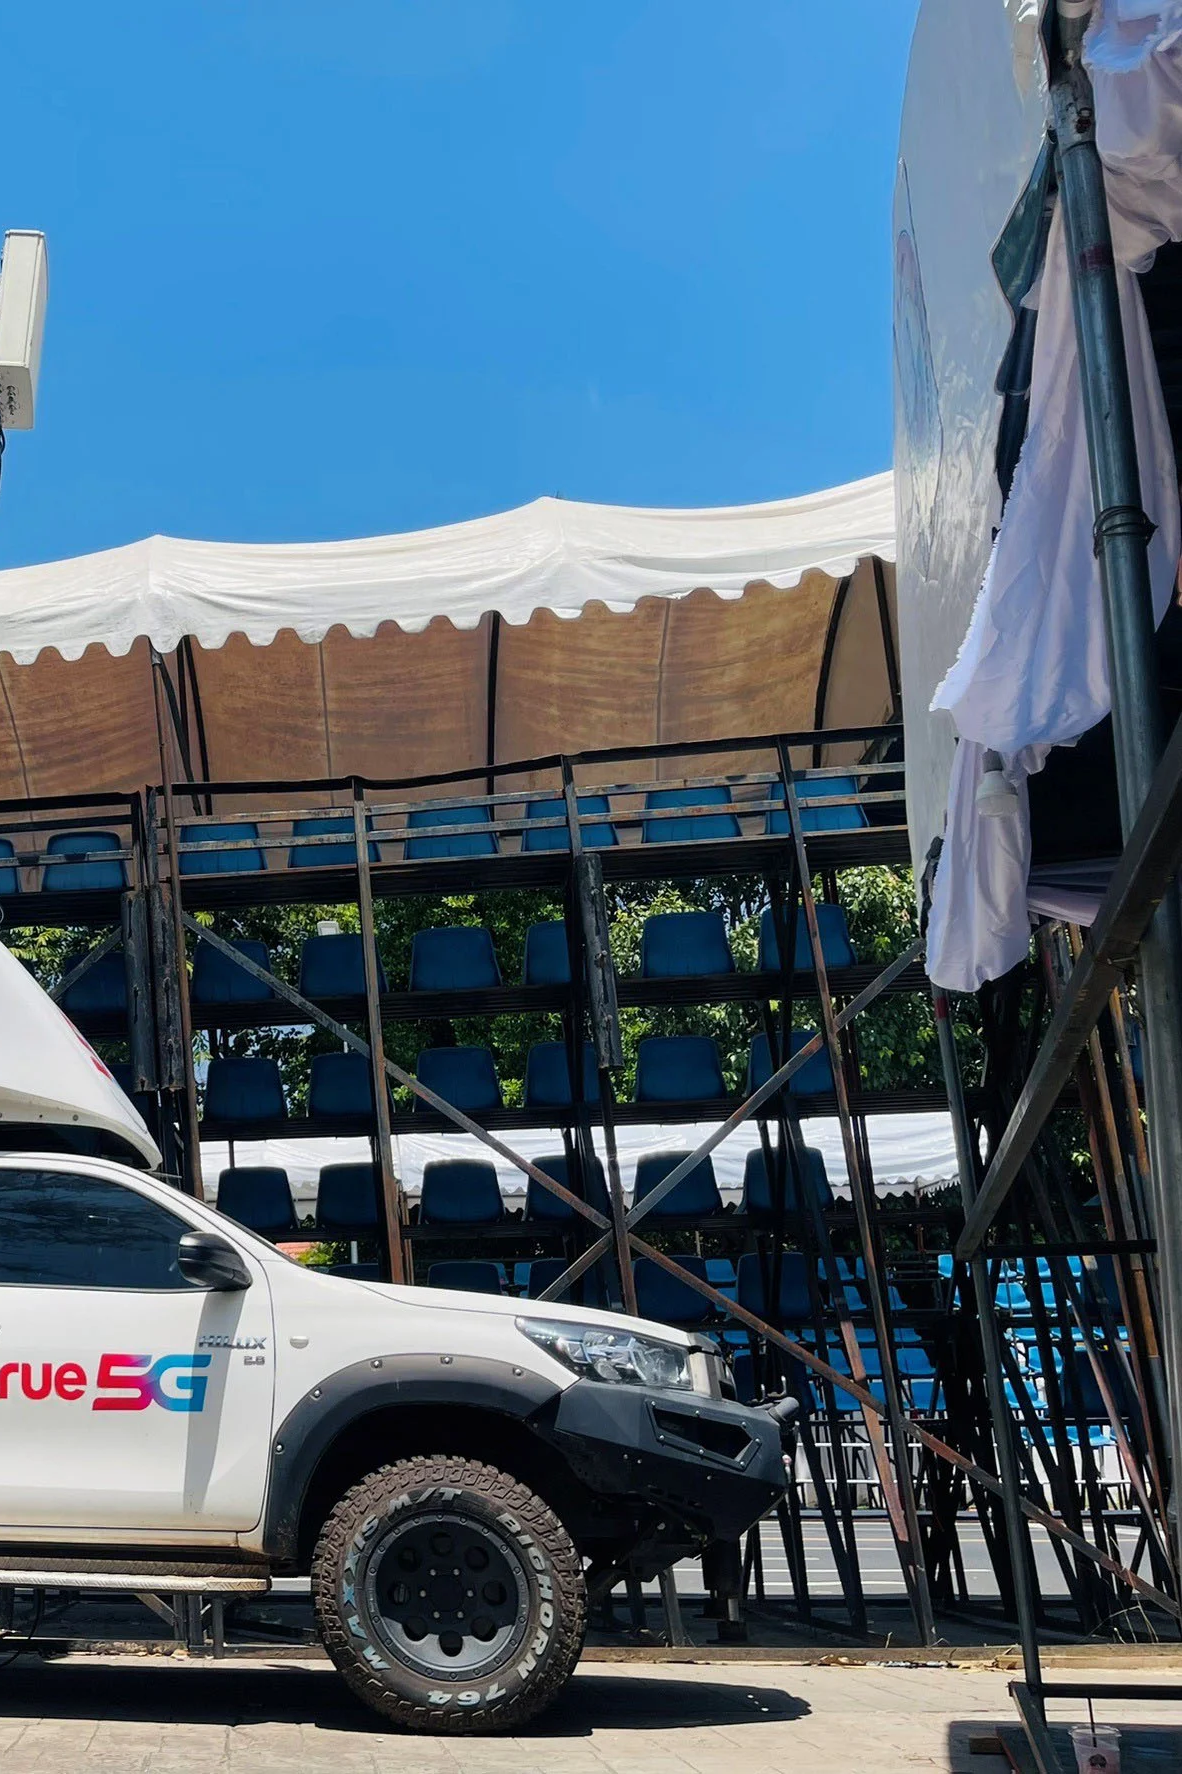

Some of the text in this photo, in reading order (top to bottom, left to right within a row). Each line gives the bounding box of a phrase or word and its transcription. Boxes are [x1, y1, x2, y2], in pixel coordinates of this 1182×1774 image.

[91, 1353, 213, 1412] 5G
[388, 1487, 463, 1512] M/T
[343, 1514, 392, 1670] MAXXIS
[495, 1513, 555, 1680] BIGHORN
